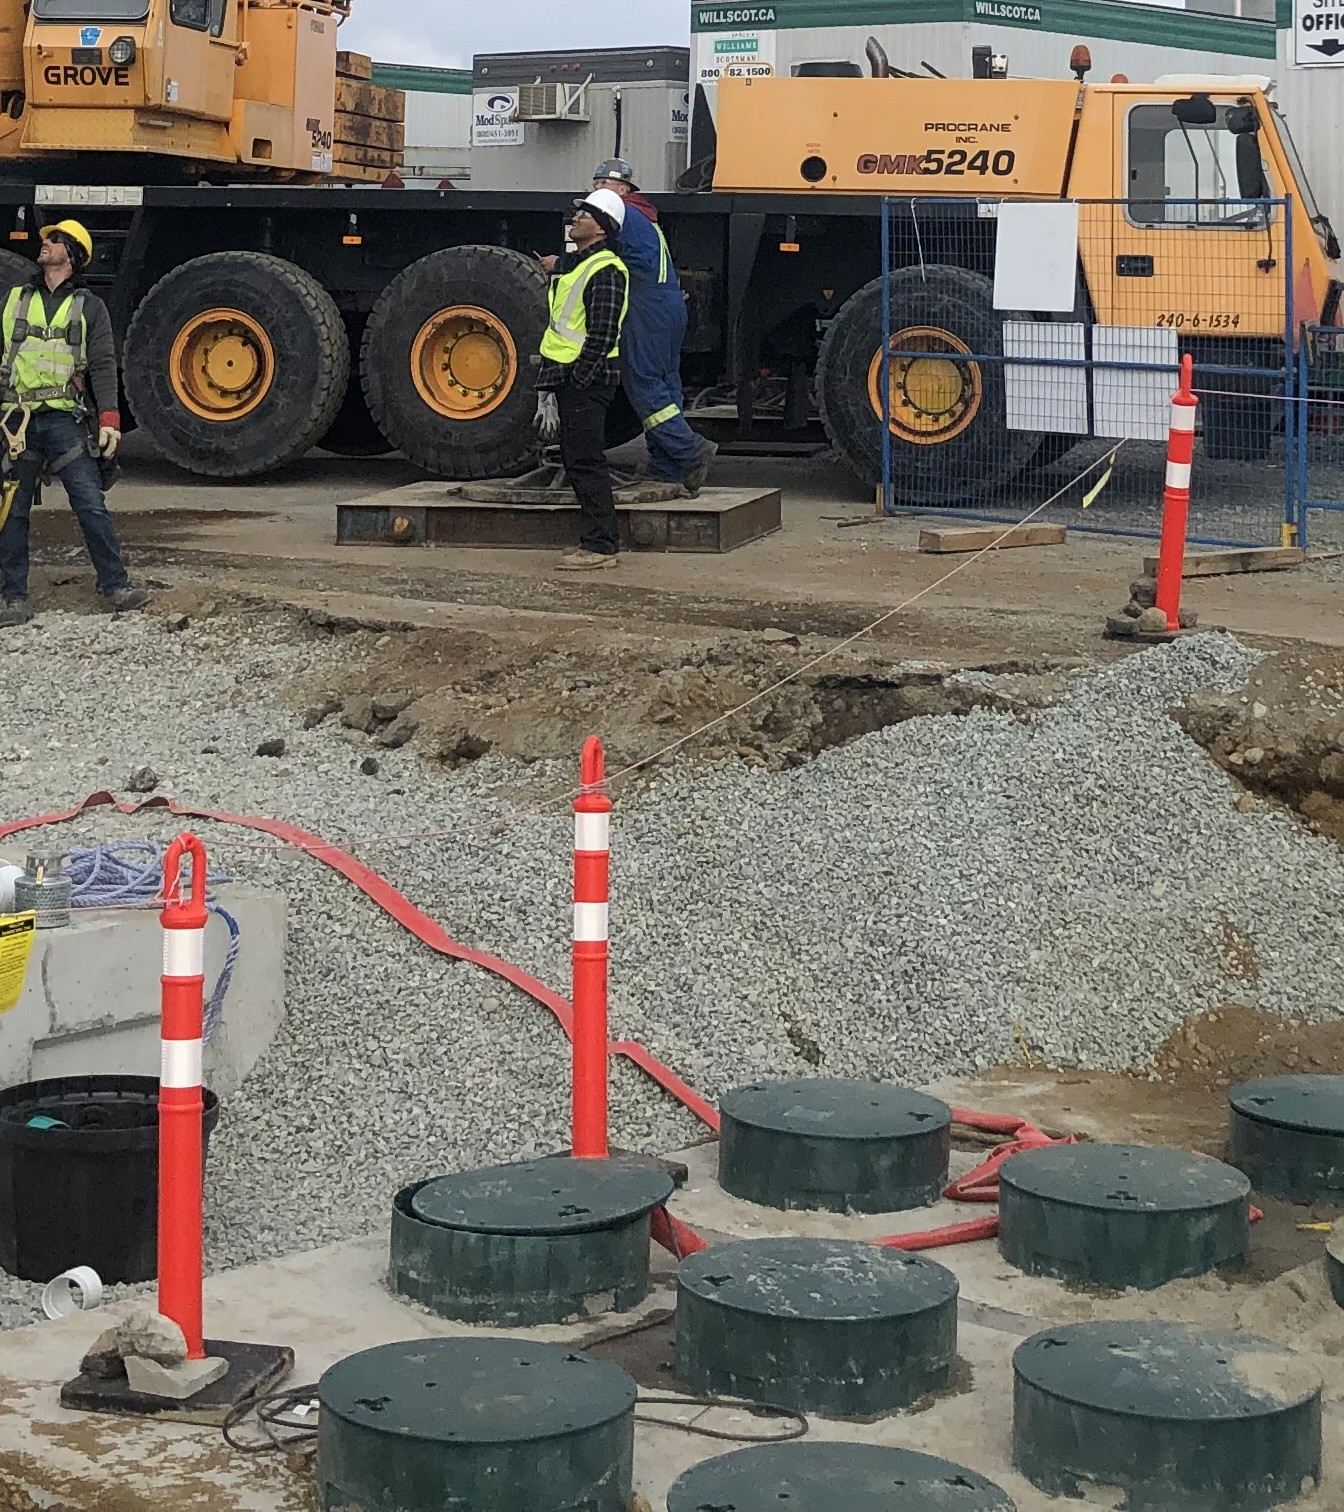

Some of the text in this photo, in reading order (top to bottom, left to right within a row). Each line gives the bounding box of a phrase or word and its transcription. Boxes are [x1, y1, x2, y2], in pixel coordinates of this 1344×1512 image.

[699, 9, 775, 23] WILLSCOT.CA
[976, 0, 1040, 21] WILLSCOT.CA
[716, 41, 757, 50] WILLIAMS
[716, 55, 756, 63] SCOTSMAN
[44, 65, 130, 86] GROVE
[924, 123, 1012, 132] PROCRANE
[955, 136, 978, 144] INC.
[1156, 311, 1240, 328] 240-6-1534
